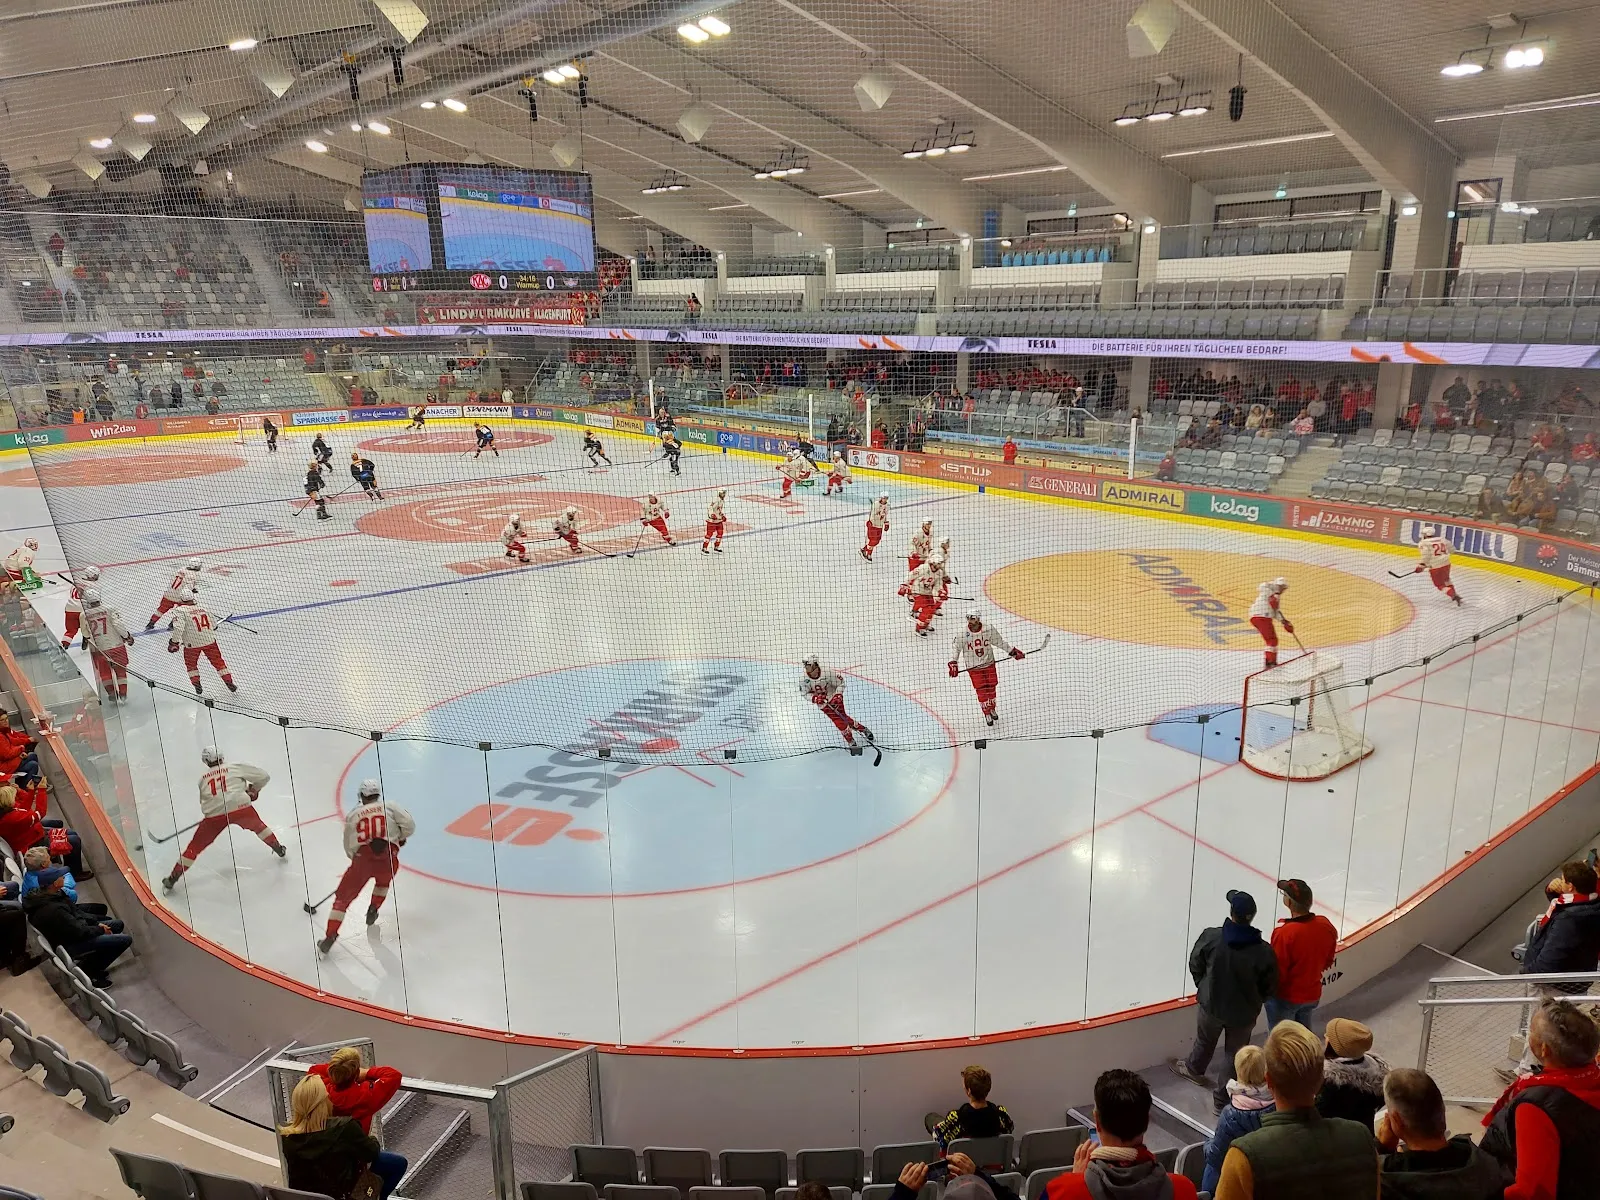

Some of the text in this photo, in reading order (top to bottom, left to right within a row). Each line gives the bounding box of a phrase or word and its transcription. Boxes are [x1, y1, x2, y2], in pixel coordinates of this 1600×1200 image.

[499, 274, 508, 289] 0
[516, 281, 540, 289] Warmup
[546, 275, 555, 290] 0
[702, 332, 718, 340] TESLA
[1028, 339, 1287, 355] TESLA DIE BATTERIE FÜR IHREN TÄGLICHEN BEDARF!
[296, 415, 338, 424] SPARKASSE
[615, 419, 643, 431] ADMIRAL
[14, 433, 49, 445] kelag
[688, 428, 707, 443] kelag
[1044, 478, 1097, 497] GENERALI
[1105, 486, 1181, 508] ADMIRAL
[1210, 495, 1260, 522] kelag
[1323, 513, 1375, 529] JAMNIG
[1381, 516, 1390, 540] TÜREN
[1432, 543, 1447, 557] 24
[1568, 553, 1579, 562] Der
[1118, 552, 1258, 645] ADMIRAL
[192, 614, 211, 632] 14
[207, 775, 228, 796] 11
[356, 815, 385, 843] 90
